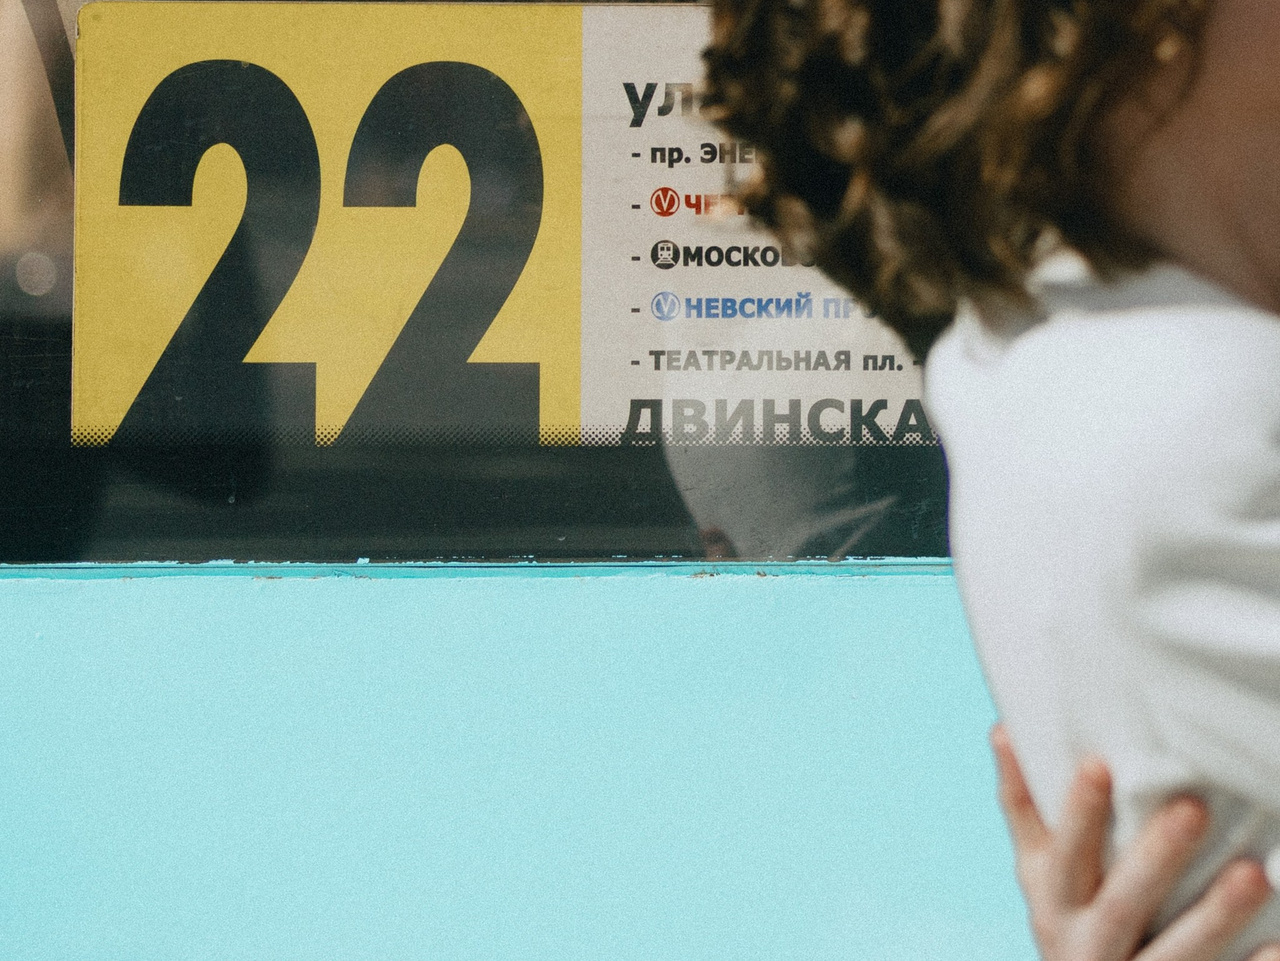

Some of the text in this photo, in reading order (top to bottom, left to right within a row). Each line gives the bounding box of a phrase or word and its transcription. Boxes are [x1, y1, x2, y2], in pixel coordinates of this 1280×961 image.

[650, 147, 691, 168] пр.
[112, 59, 543, 444] 22
[682, 245, 816, 268] МОСКО
[685, 292, 813, 319] НЕВСКИЙ
[649, 350, 904, 371] ТЕАТРАЛЬНАЯ пл.
